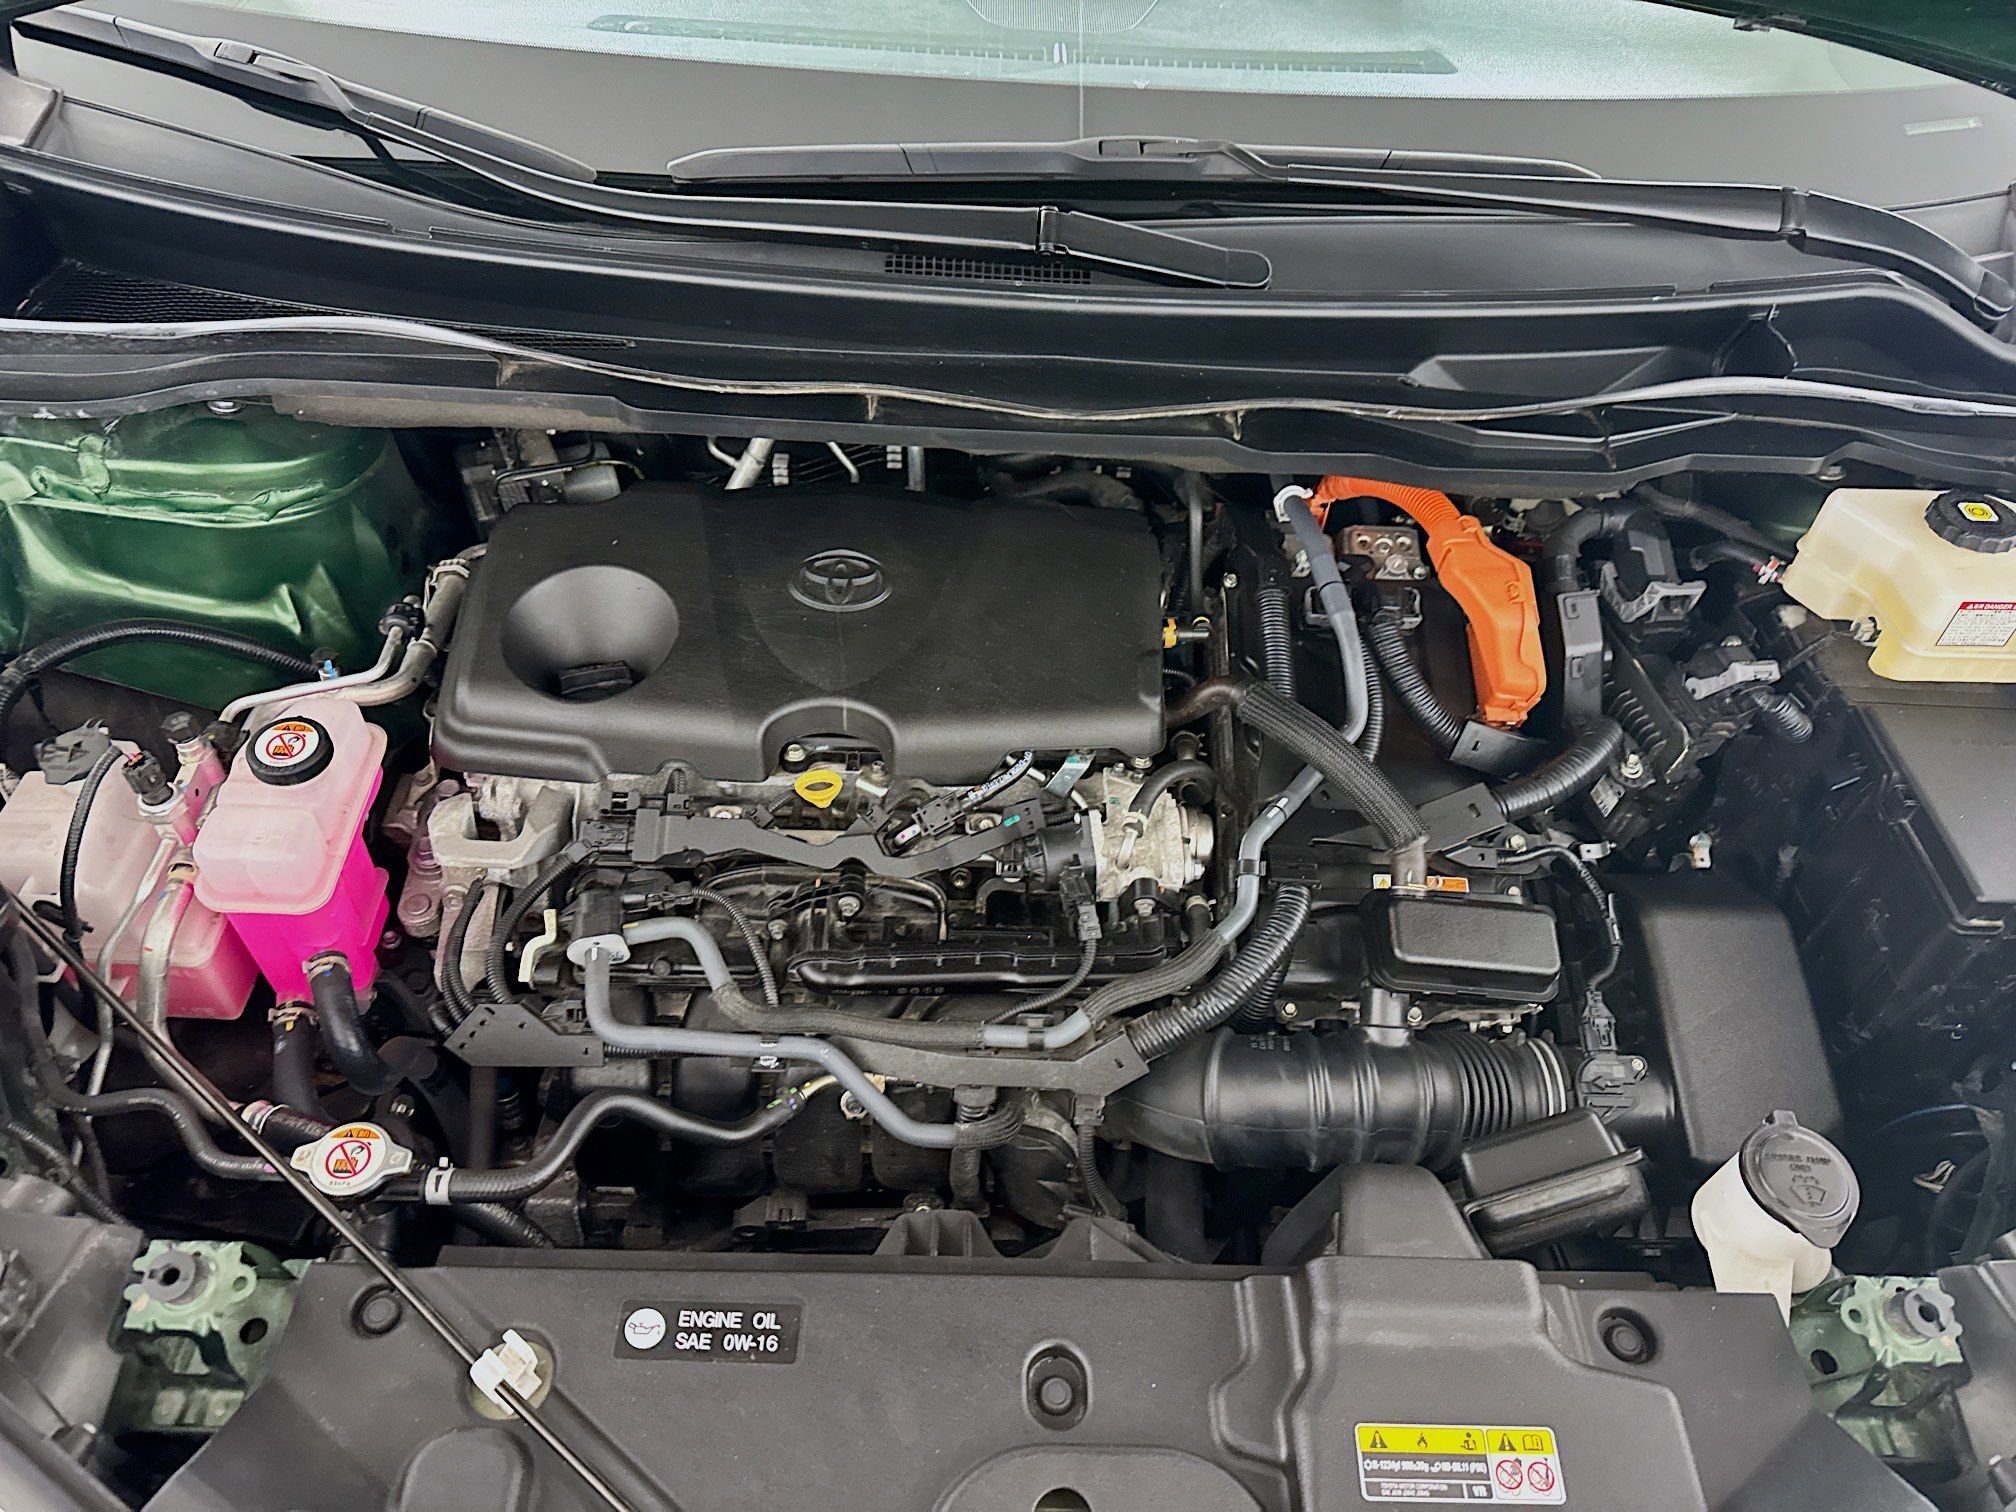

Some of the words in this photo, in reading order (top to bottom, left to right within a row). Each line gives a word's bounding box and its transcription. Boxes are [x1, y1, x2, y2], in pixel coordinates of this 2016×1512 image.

[677, 1310, 744, 1329] ENGINE
[752, 1312, 781, 1330] OIL
[674, 1332, 713, 1350] SAE
[722, 1334, 779, 1352] 0W-16
